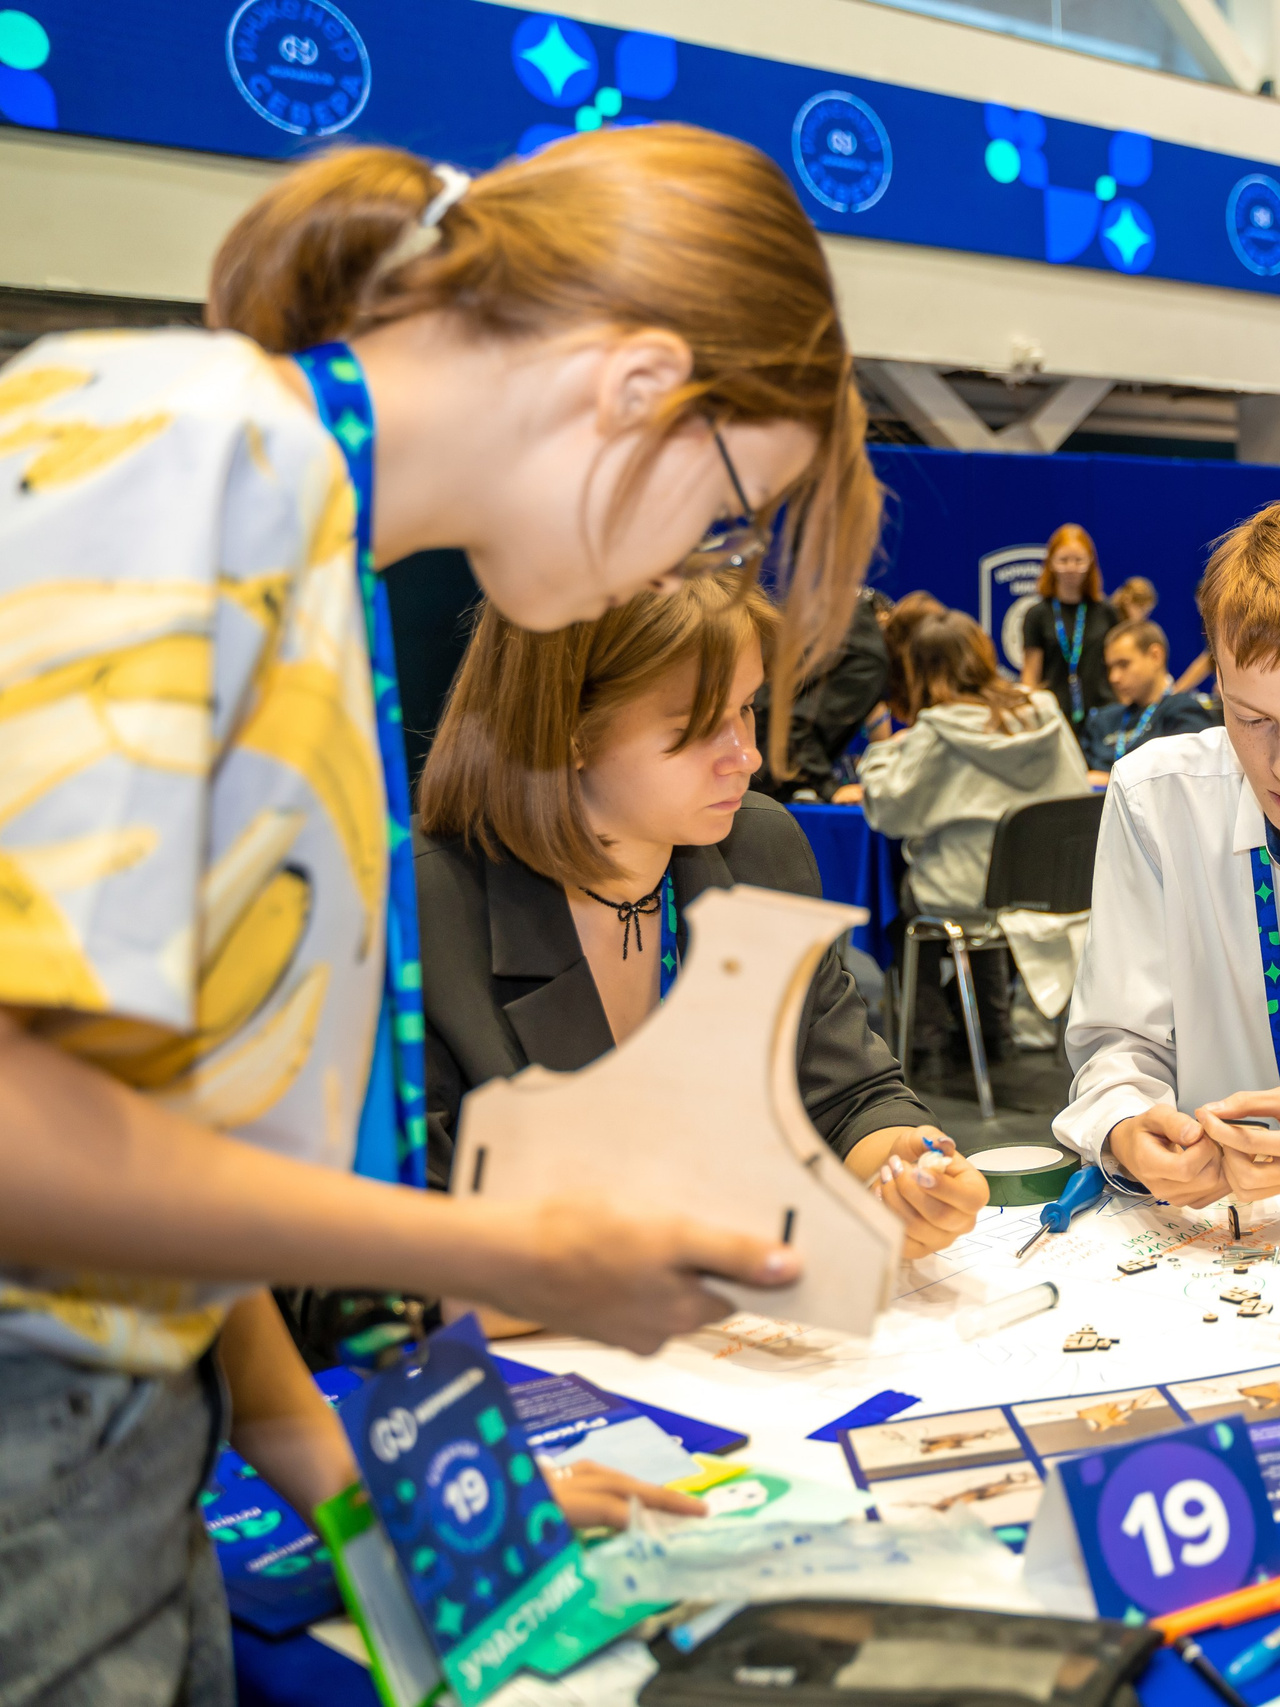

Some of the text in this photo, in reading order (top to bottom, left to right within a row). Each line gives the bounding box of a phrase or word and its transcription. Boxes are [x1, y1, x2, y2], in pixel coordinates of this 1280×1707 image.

[442, 1466, 490, 1524] 19
[1121, 1478, 1230, 1578] 19
[457, 1562, 585, 1692] УЧАСТНИК
